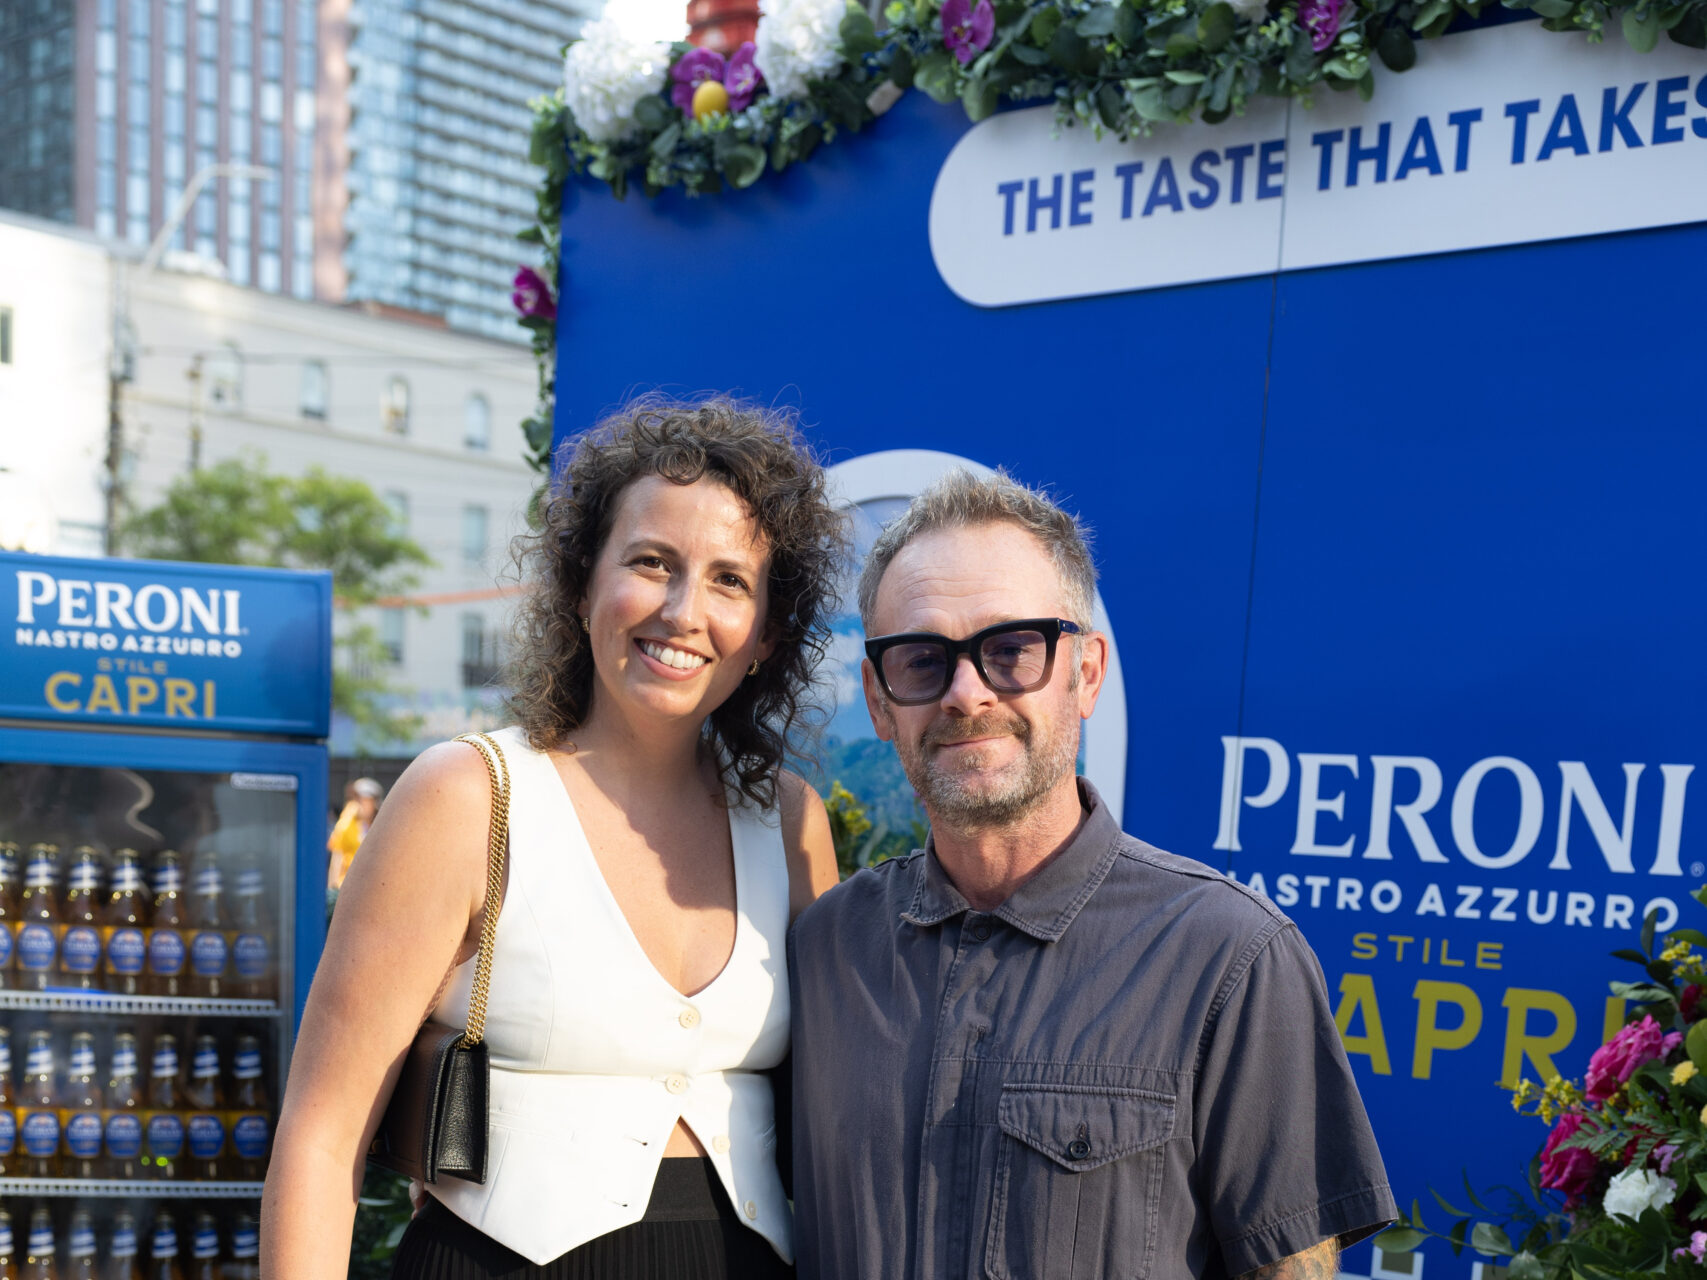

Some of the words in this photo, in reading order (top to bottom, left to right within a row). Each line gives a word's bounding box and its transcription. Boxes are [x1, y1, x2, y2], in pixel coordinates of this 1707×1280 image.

[997, 168, 1095, 236] THE
[1115, 138, 1286, 220] TASTE
[1311, 107, 1483, 192] THAT
[15, 571, 242, 636] PERONI
[15, 628, 119, 651] NASTRO
[122, 634, 242, 659] AZZURRO
[97, 657, 168, 675] STILE
[44, 671, 217, 719] CAPRI
[1212, 736, 1696, 877] PERONI
[1227, 870, 1402, 914] ASTRO
[1416, 884, 1679, 933] AZZURRO
[1351, 931, 1504, 970] STILE
